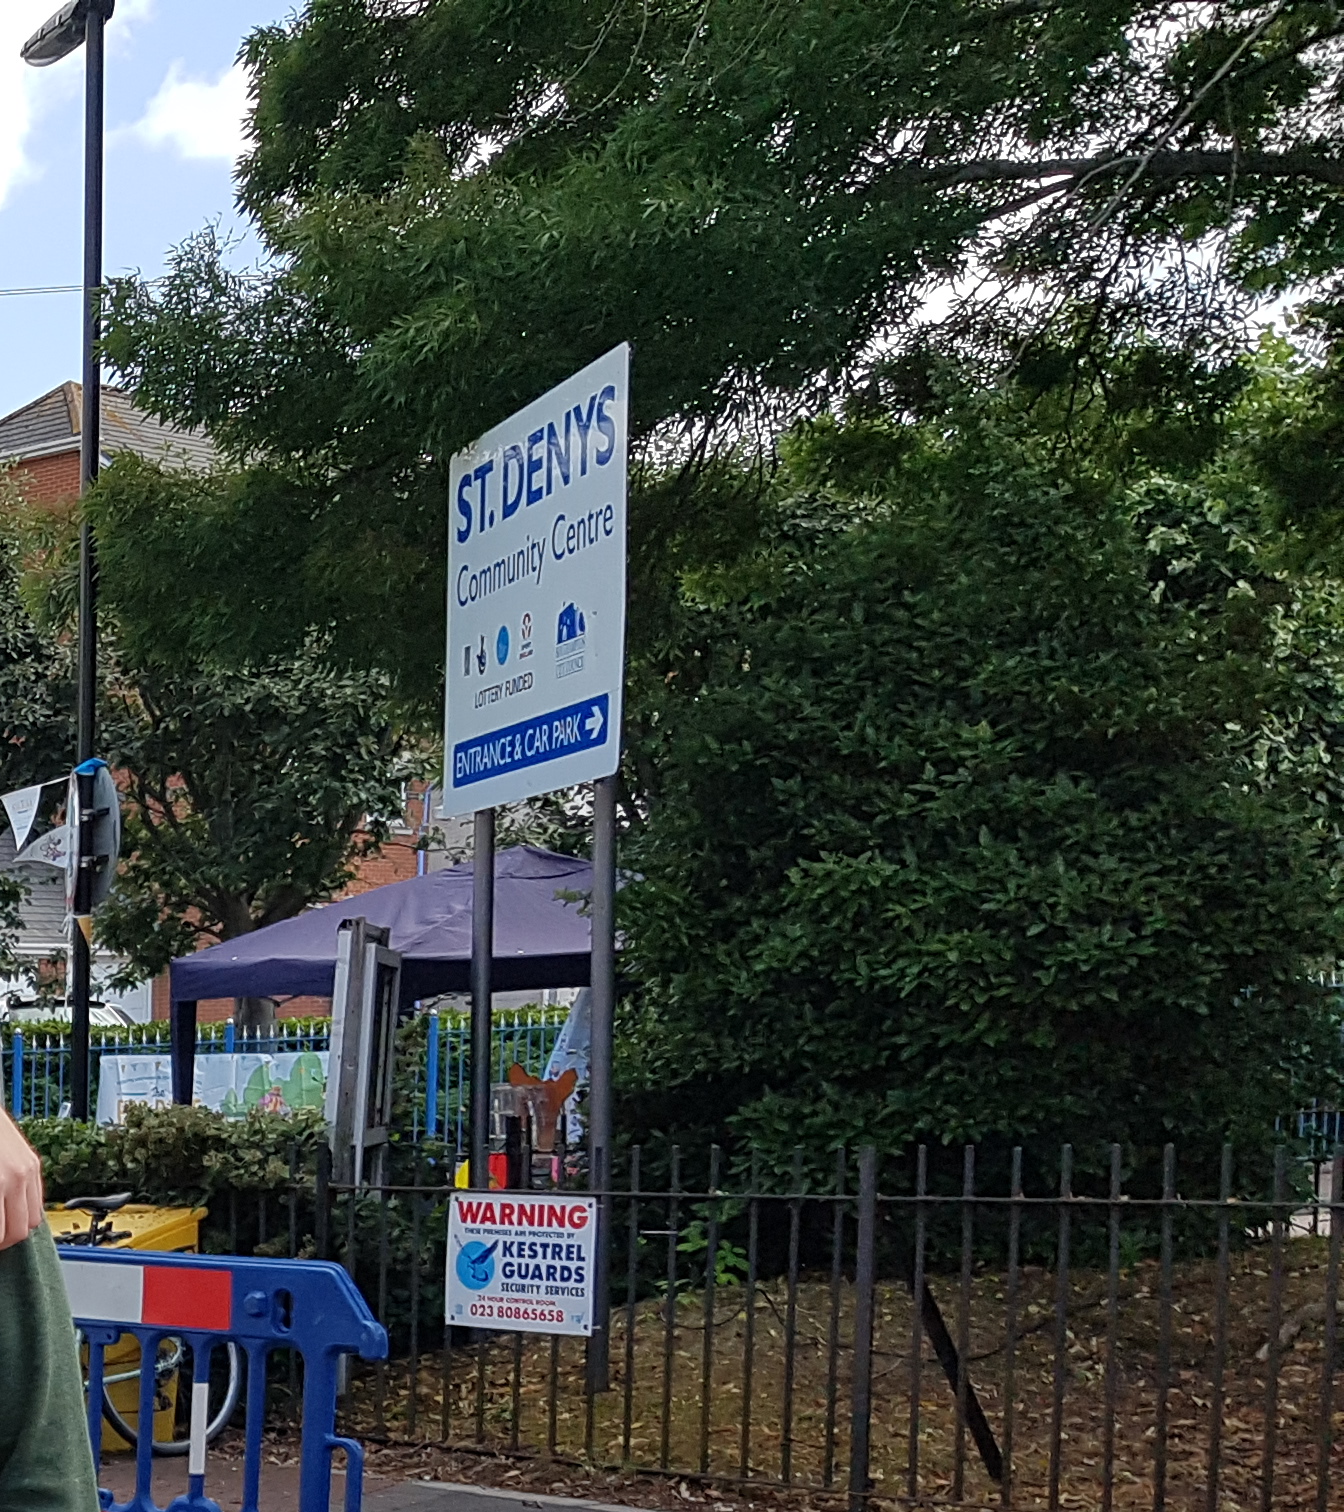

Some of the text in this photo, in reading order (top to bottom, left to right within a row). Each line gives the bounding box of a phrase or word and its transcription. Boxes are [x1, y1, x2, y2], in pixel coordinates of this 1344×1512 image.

[502, 385, 616, 521] DENYS
[457, 504, 614, 607] Community Centre
[474, 672, 533, 708] LOTTERY FUNDED
[456, 713, 582, 779] ENTRANCE & CAR PARK
[457, 1201, 589, 1230] WARNING
[483, 1228, 512, 1236] PREMISES
[514, 1229, 526, 1237] ARE
[528, 1230, 565, 1239] PROTECTED
[502, 1240, 587, 1262] KESTREL
[502, 1261, 586, 1284] GUARDS
[477, 1294, 486, 1302] 24
[506, 1297, 534, 1306] CONTROL
[535, 1299, 556, 1307] ROOM
[500, 1282, 585, 1298] SECURITY SERVICES
[470, 1303, 494, 1318] 023
[497, 1305, 564, 1323] 80865658
